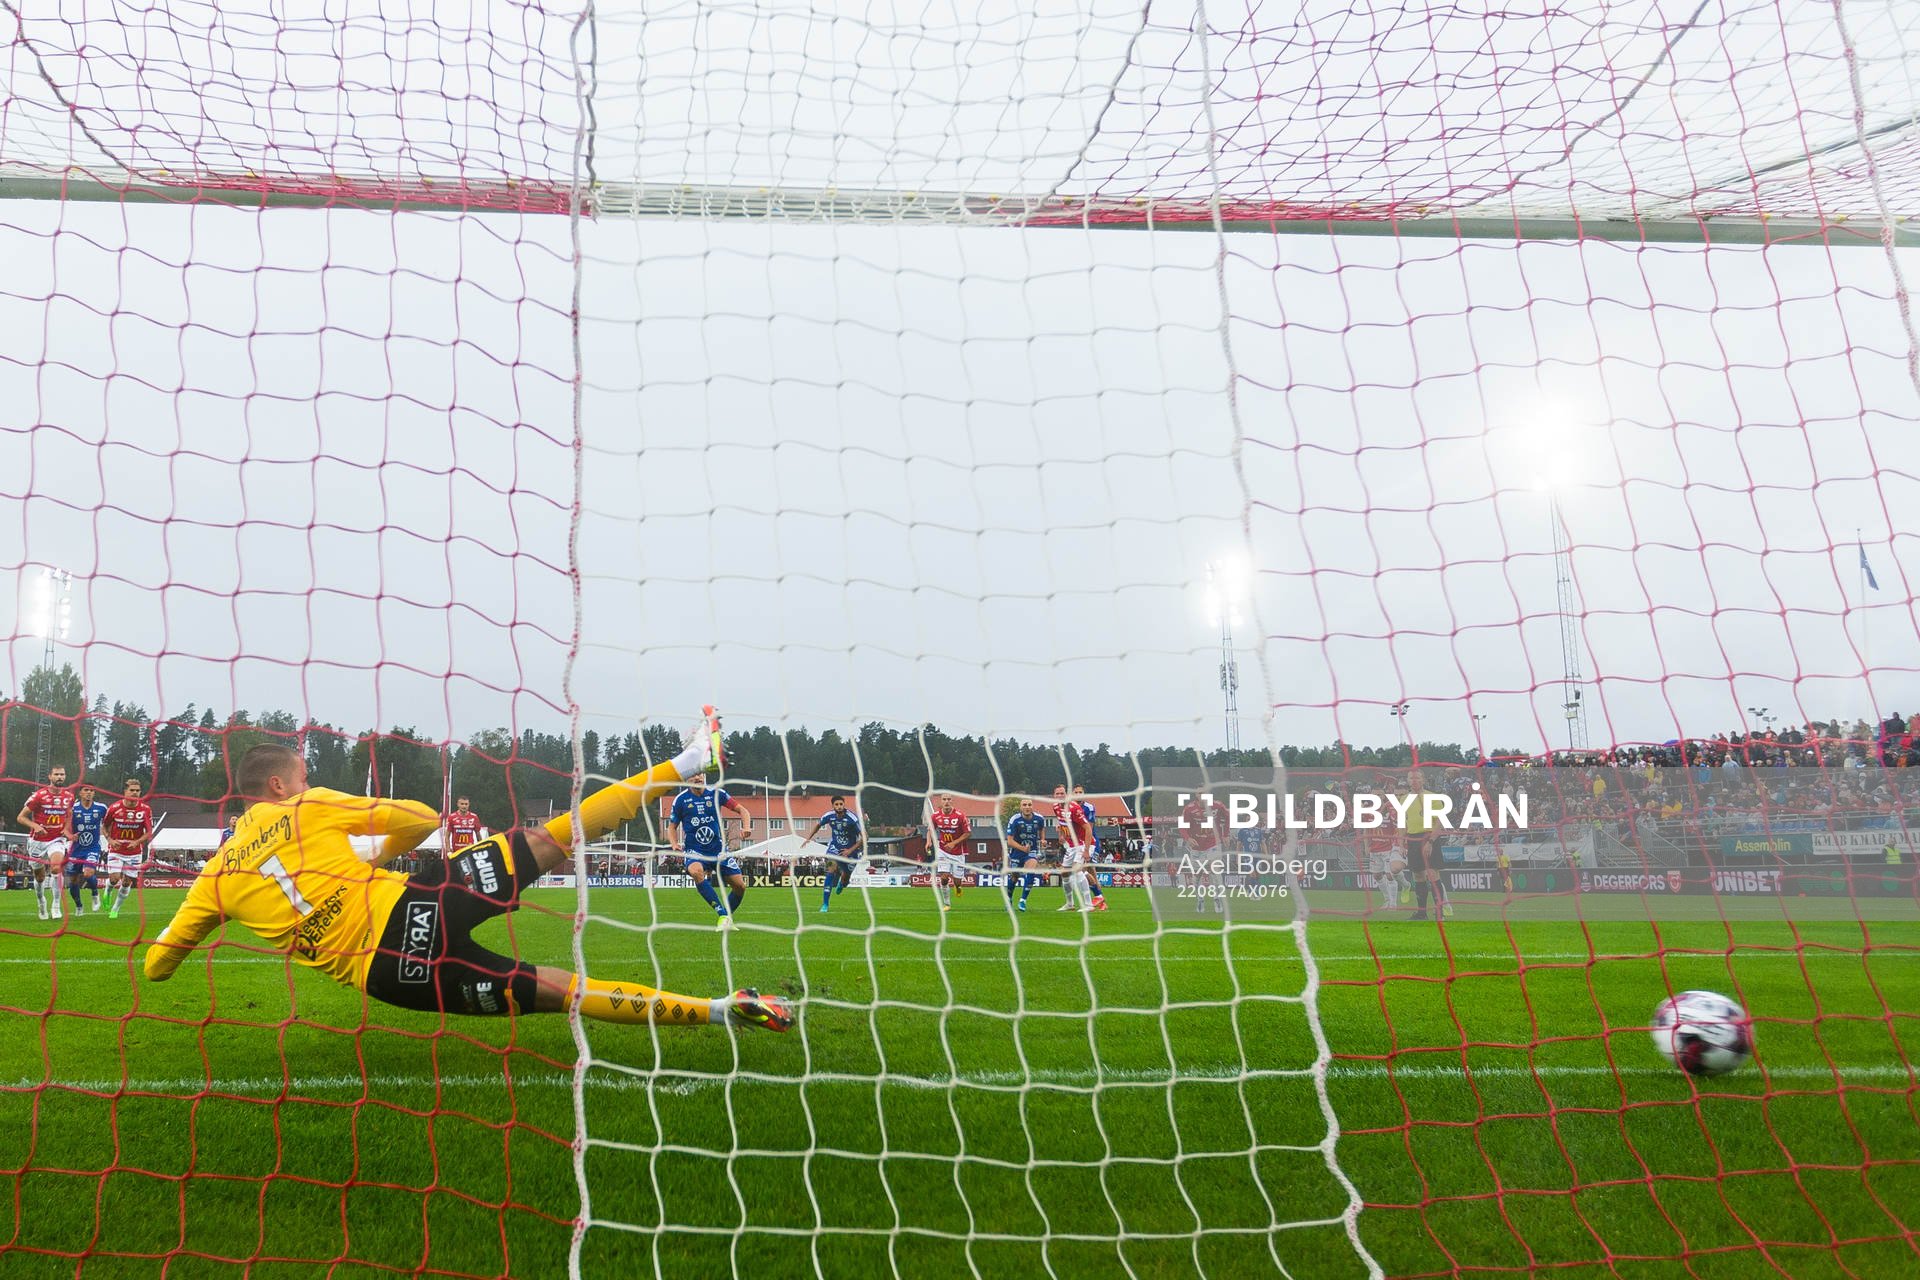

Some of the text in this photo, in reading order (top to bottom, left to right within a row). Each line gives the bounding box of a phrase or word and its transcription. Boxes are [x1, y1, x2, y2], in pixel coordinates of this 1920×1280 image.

[700, 815, 715, 824] SCA
[224, 814, 292, 876] Björnberg
[1850, 833, 1886, 845] KMAB
[473, 849, 498, 894] EMPE
[753, 875, 826, 887] XL-BYGG
[1451, 873, 1492, 889] UNIBET
[1711, 870, 1783, 892] UNIBET
[258, 854, 314, 917] 1
[1594, 874, 1665, 890] DEGERFORS
[310, 899, 343, 944] Energi
